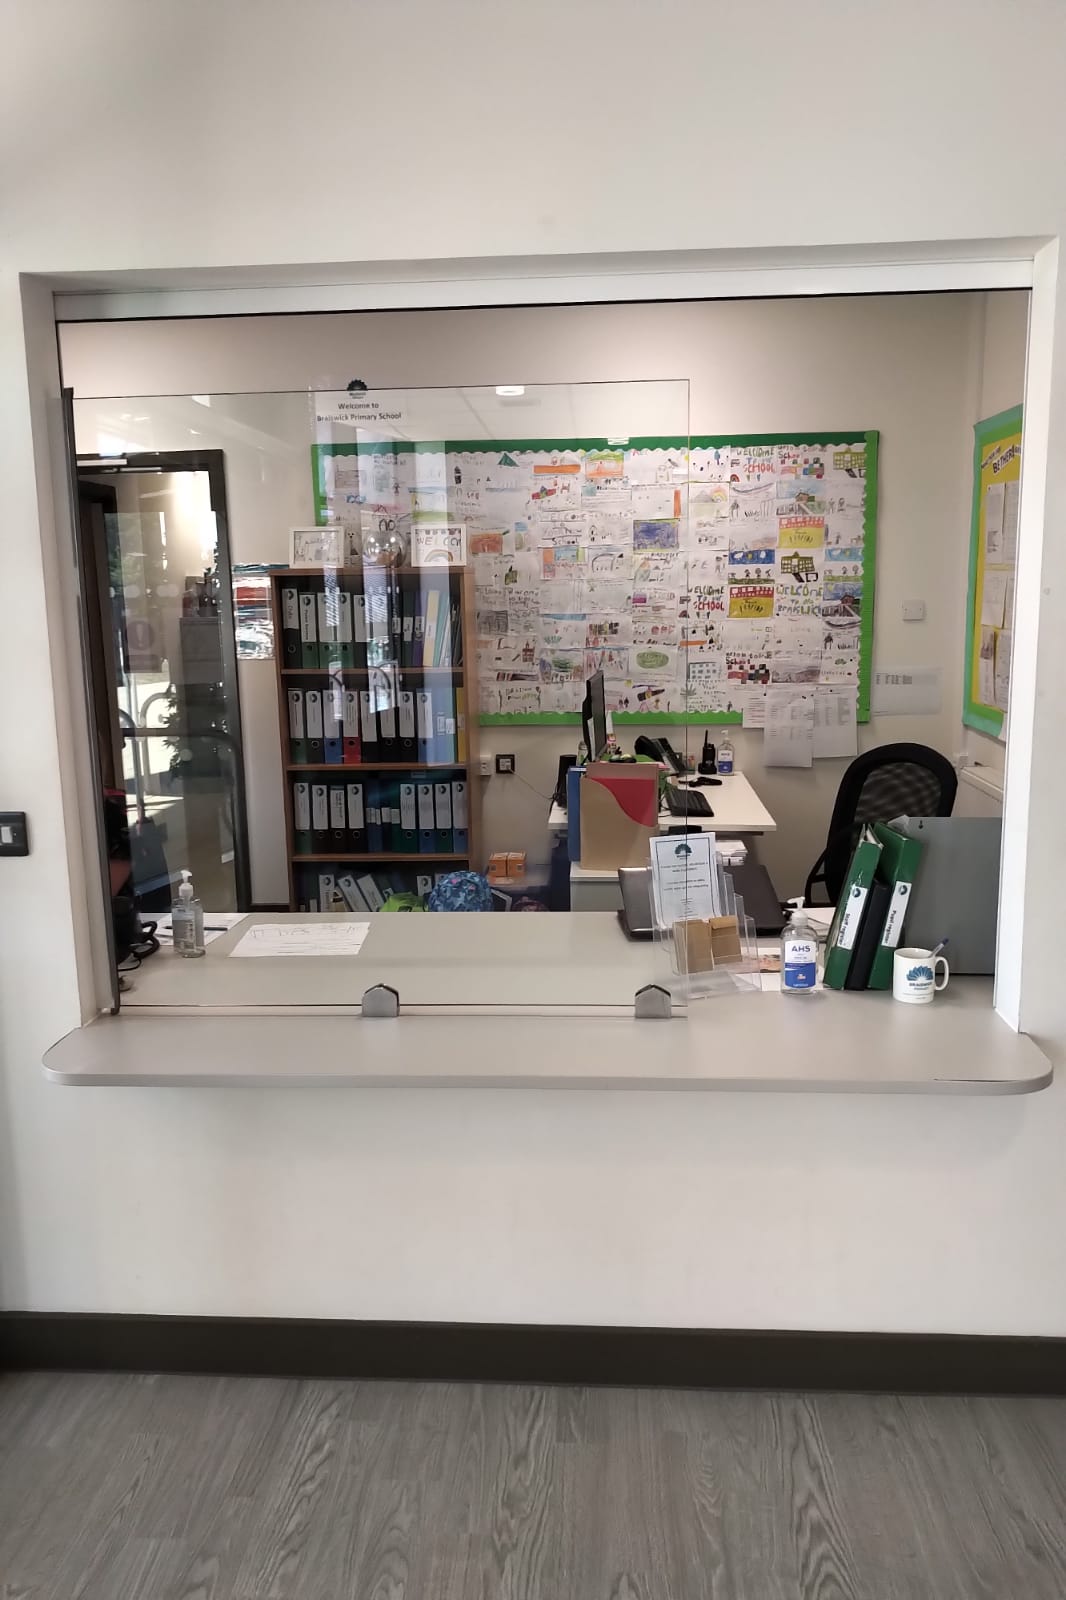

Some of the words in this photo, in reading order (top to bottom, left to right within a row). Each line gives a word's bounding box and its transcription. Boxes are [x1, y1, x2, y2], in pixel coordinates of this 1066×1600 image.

[350, 413, 377, 421] Primary
[378, 412, 402, 420] School
[693, 601, 724, 611] SCHOOL
[889, 910, 897, 923] Pupil
[884, 923, 892, 943] register
[791, 945, 811, 953] AHS
